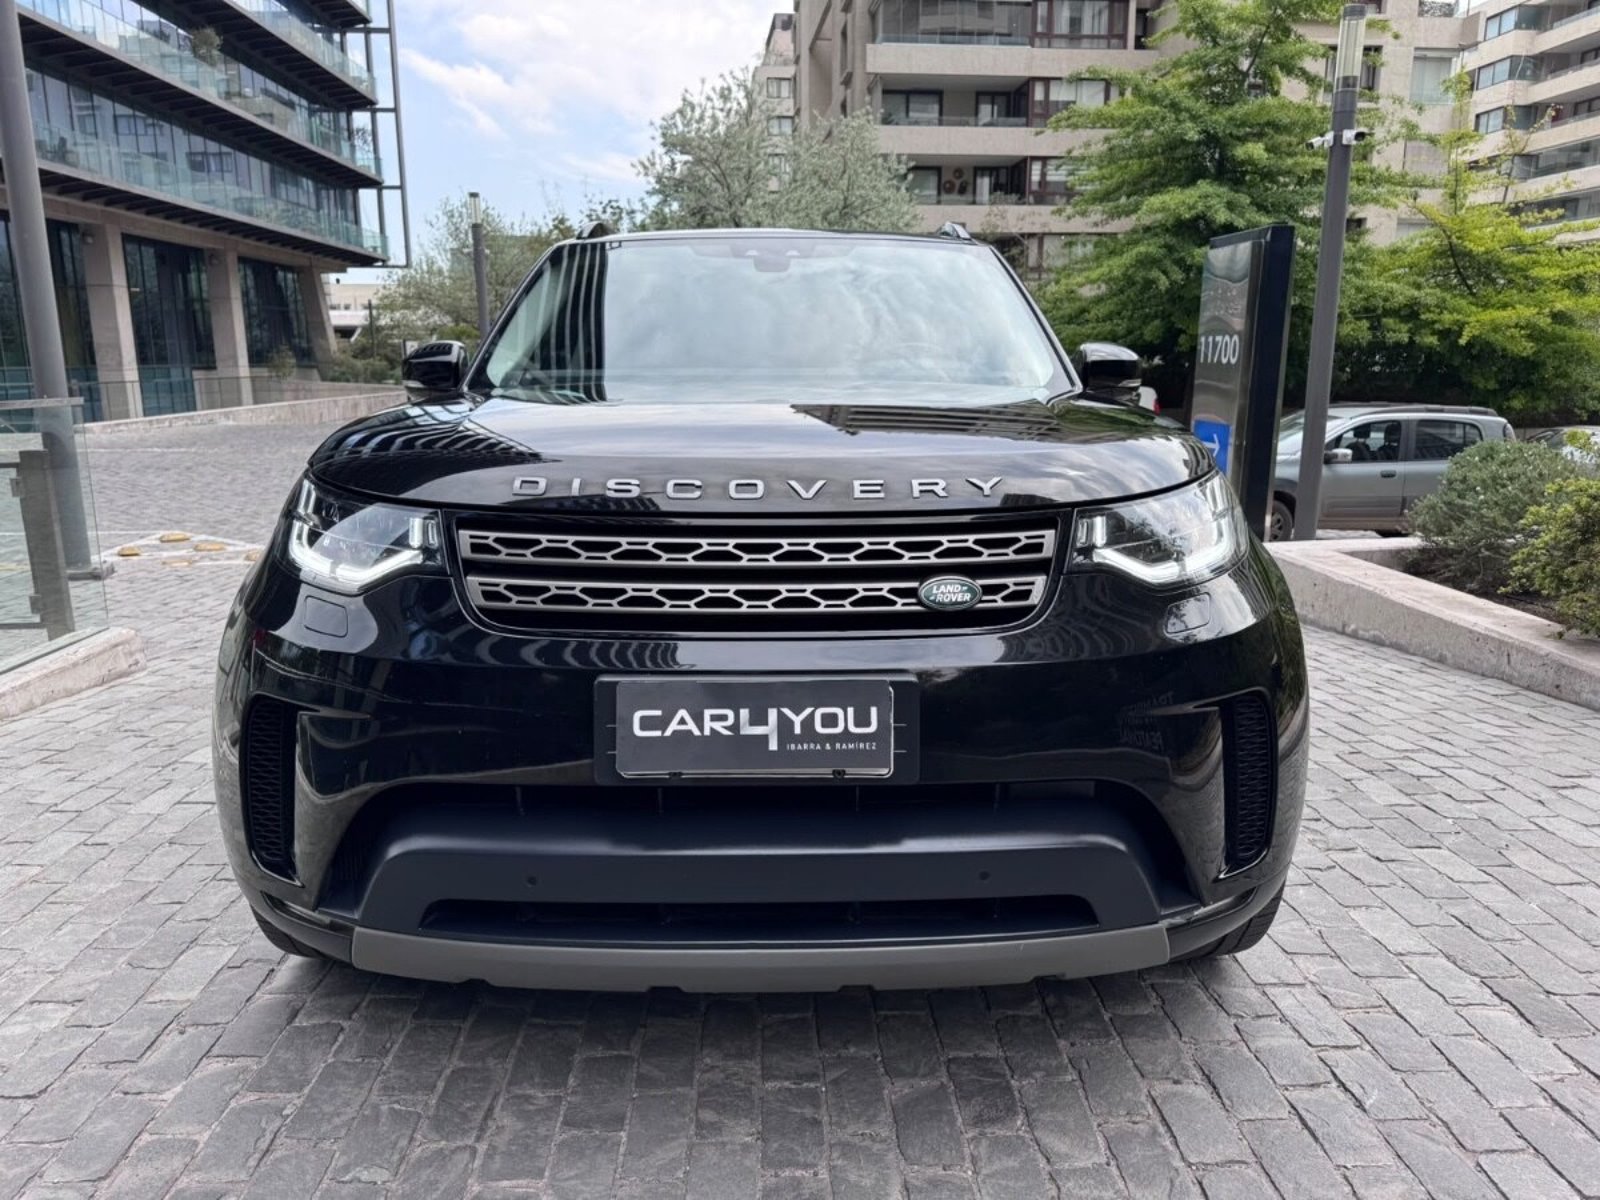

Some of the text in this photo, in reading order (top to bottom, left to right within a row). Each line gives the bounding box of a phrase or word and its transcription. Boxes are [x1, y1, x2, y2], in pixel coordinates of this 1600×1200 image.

[1200, 334, 1240, 365] 11700
[511, 476, 1003, 500] DISCOVERY
[632, 706, 878, 751] CAR4YOU
[786, 743, 822, 751] IBARRA
[825, 743, 832, 751] &
